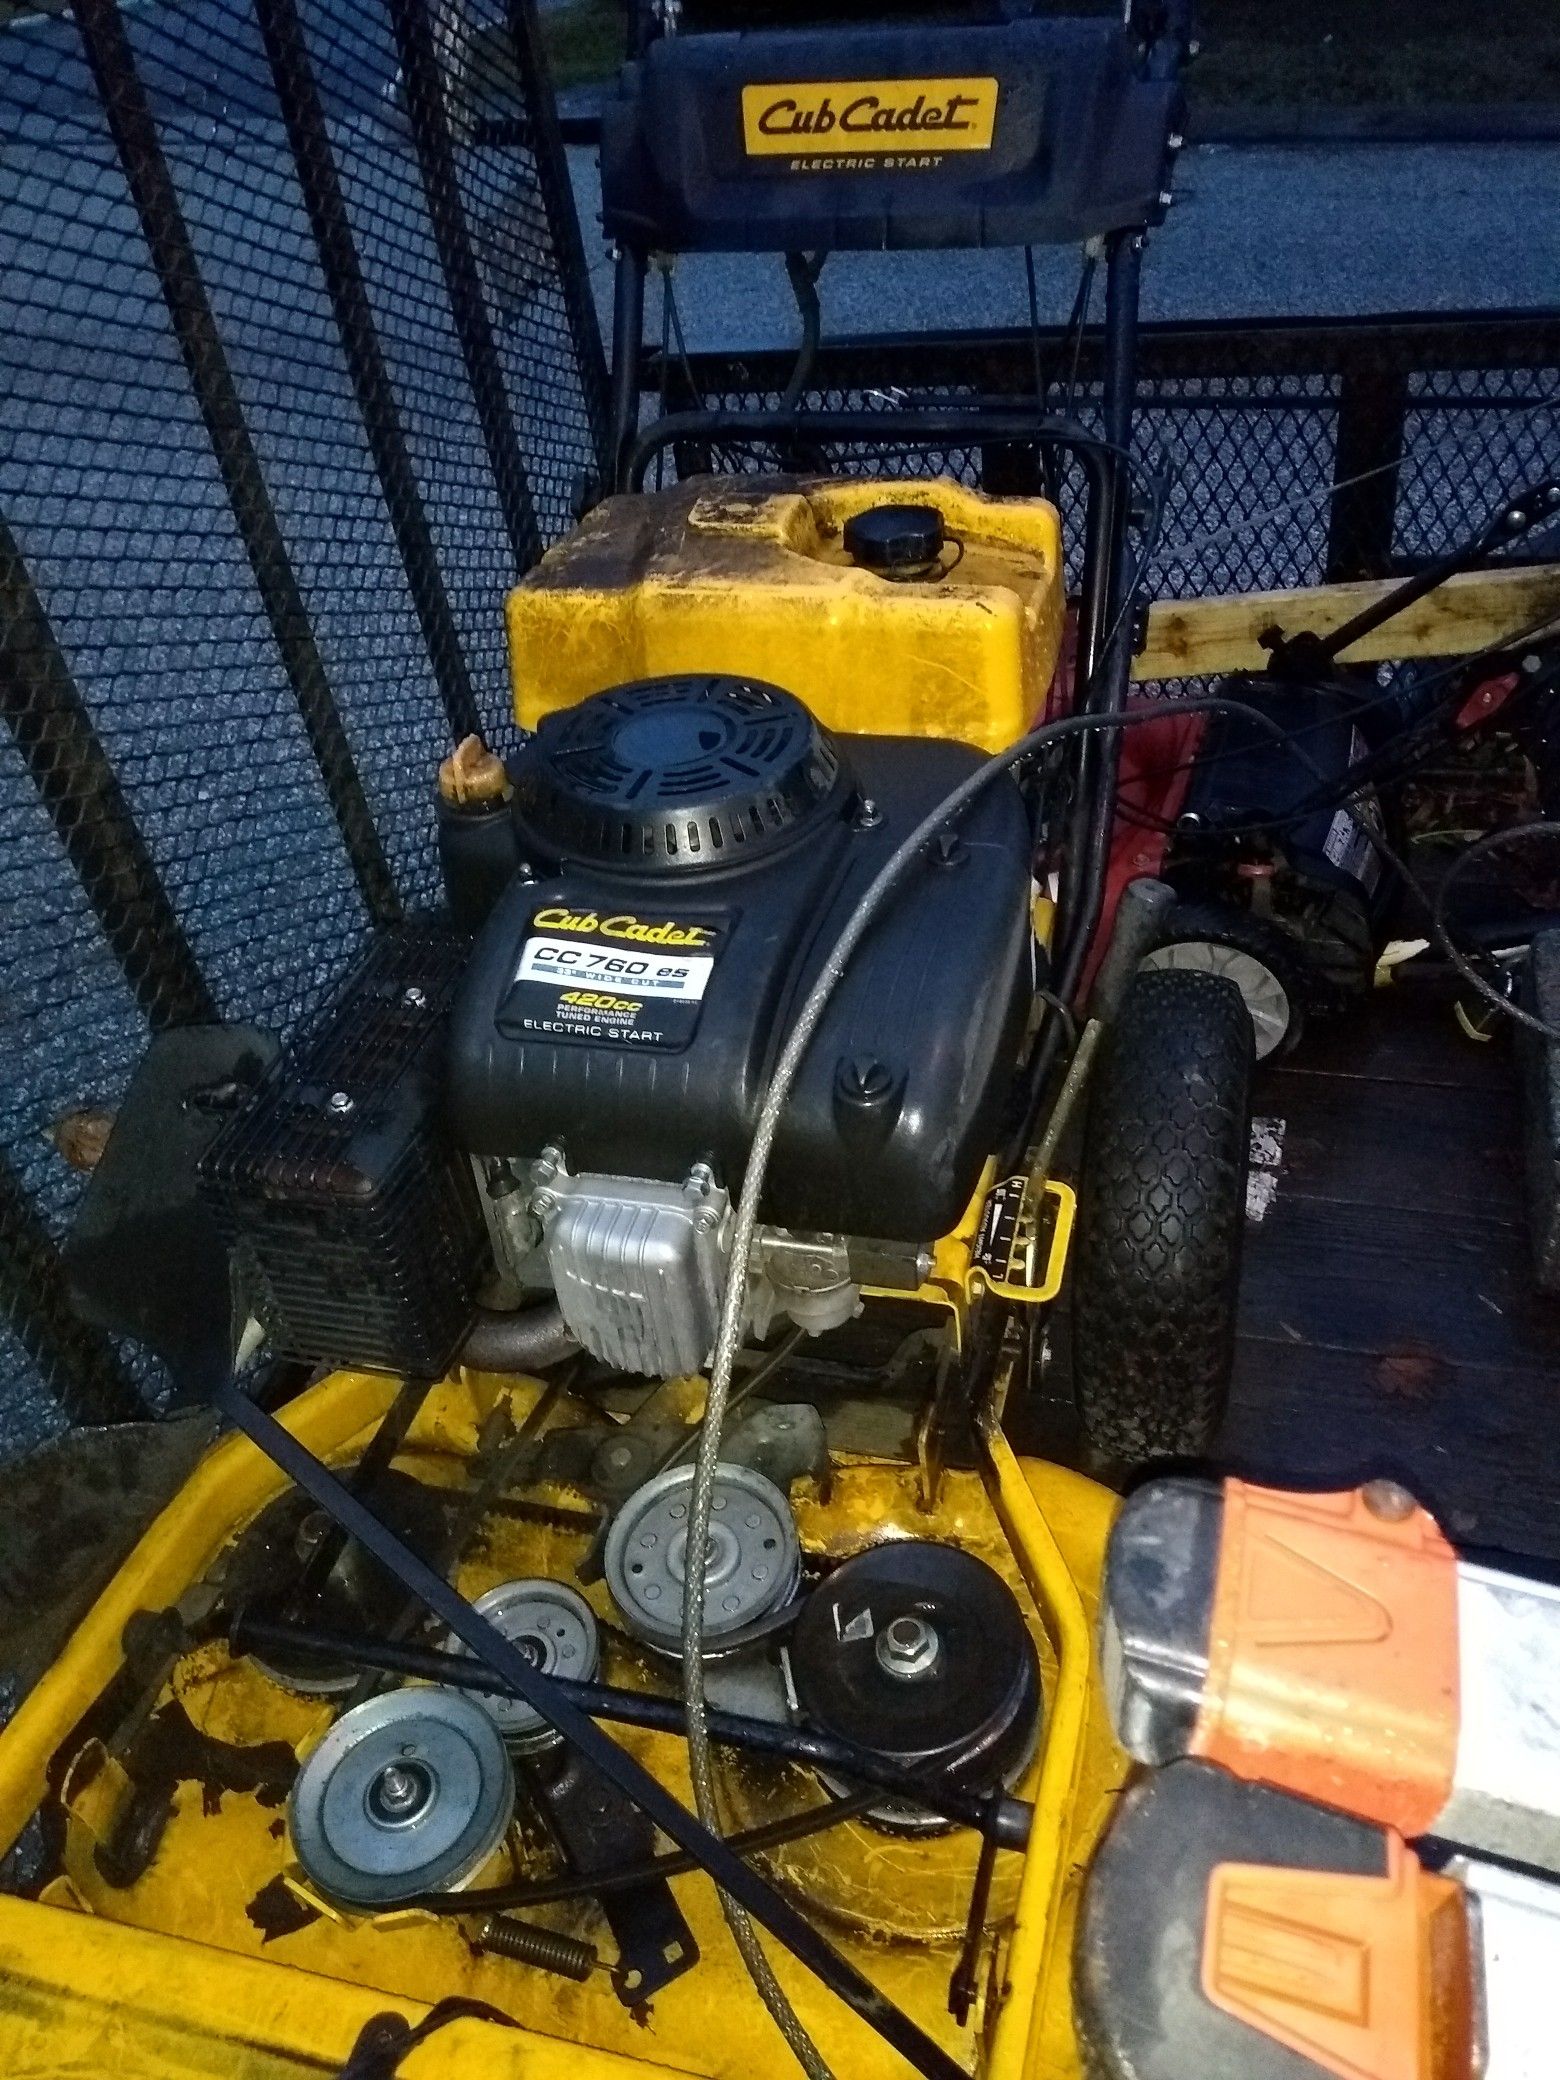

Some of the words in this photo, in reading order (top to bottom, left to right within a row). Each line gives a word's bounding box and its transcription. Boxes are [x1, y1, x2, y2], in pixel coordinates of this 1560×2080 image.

[758, 99, 836, 134] Cub
[839, 95, 979, 132] Cadet
[790, 157, 876, 170] ELECTRIC
[884, 156, 943, 169] START
[533, 908, 599, 933] Cub
[600, 915, 717, 946] Cadet
[534, 947, 582, 964] CC
[586, 954, 649, 974] 760
[586, 972, 622, 984] WIDE
[557, 1003, 637, 1019] PERFORMANCE
[560, 991, 643, 1012] 420cc
[556, 1010, 591, 1021] TUNED
[594, 1014, 636, 1026] ENGINE
[523, 1019, 602, 1037] ELECTRIC
[608, 1028, 664, 1042] START
